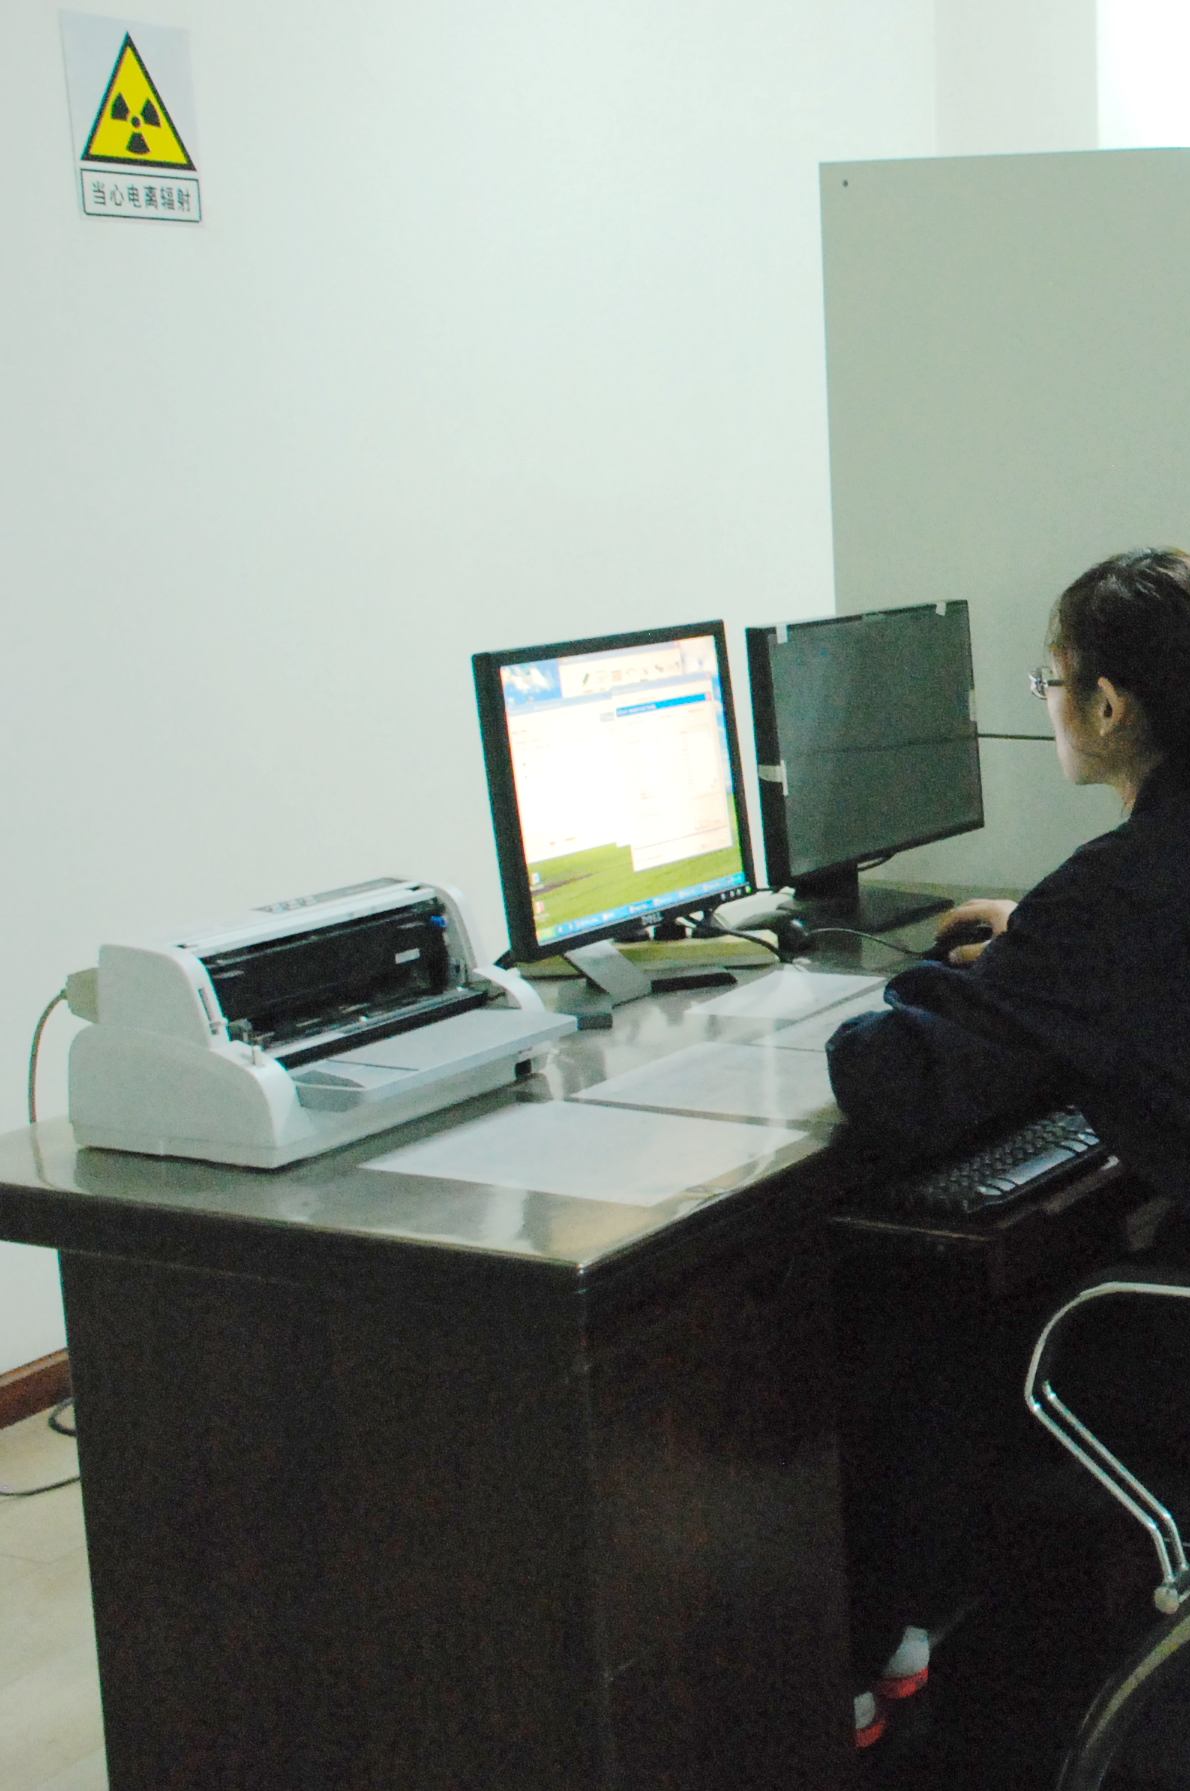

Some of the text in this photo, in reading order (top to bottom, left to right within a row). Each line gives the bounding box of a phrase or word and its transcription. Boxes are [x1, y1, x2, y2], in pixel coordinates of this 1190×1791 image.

[92, 182, 190, 211] 当心电离辐射
